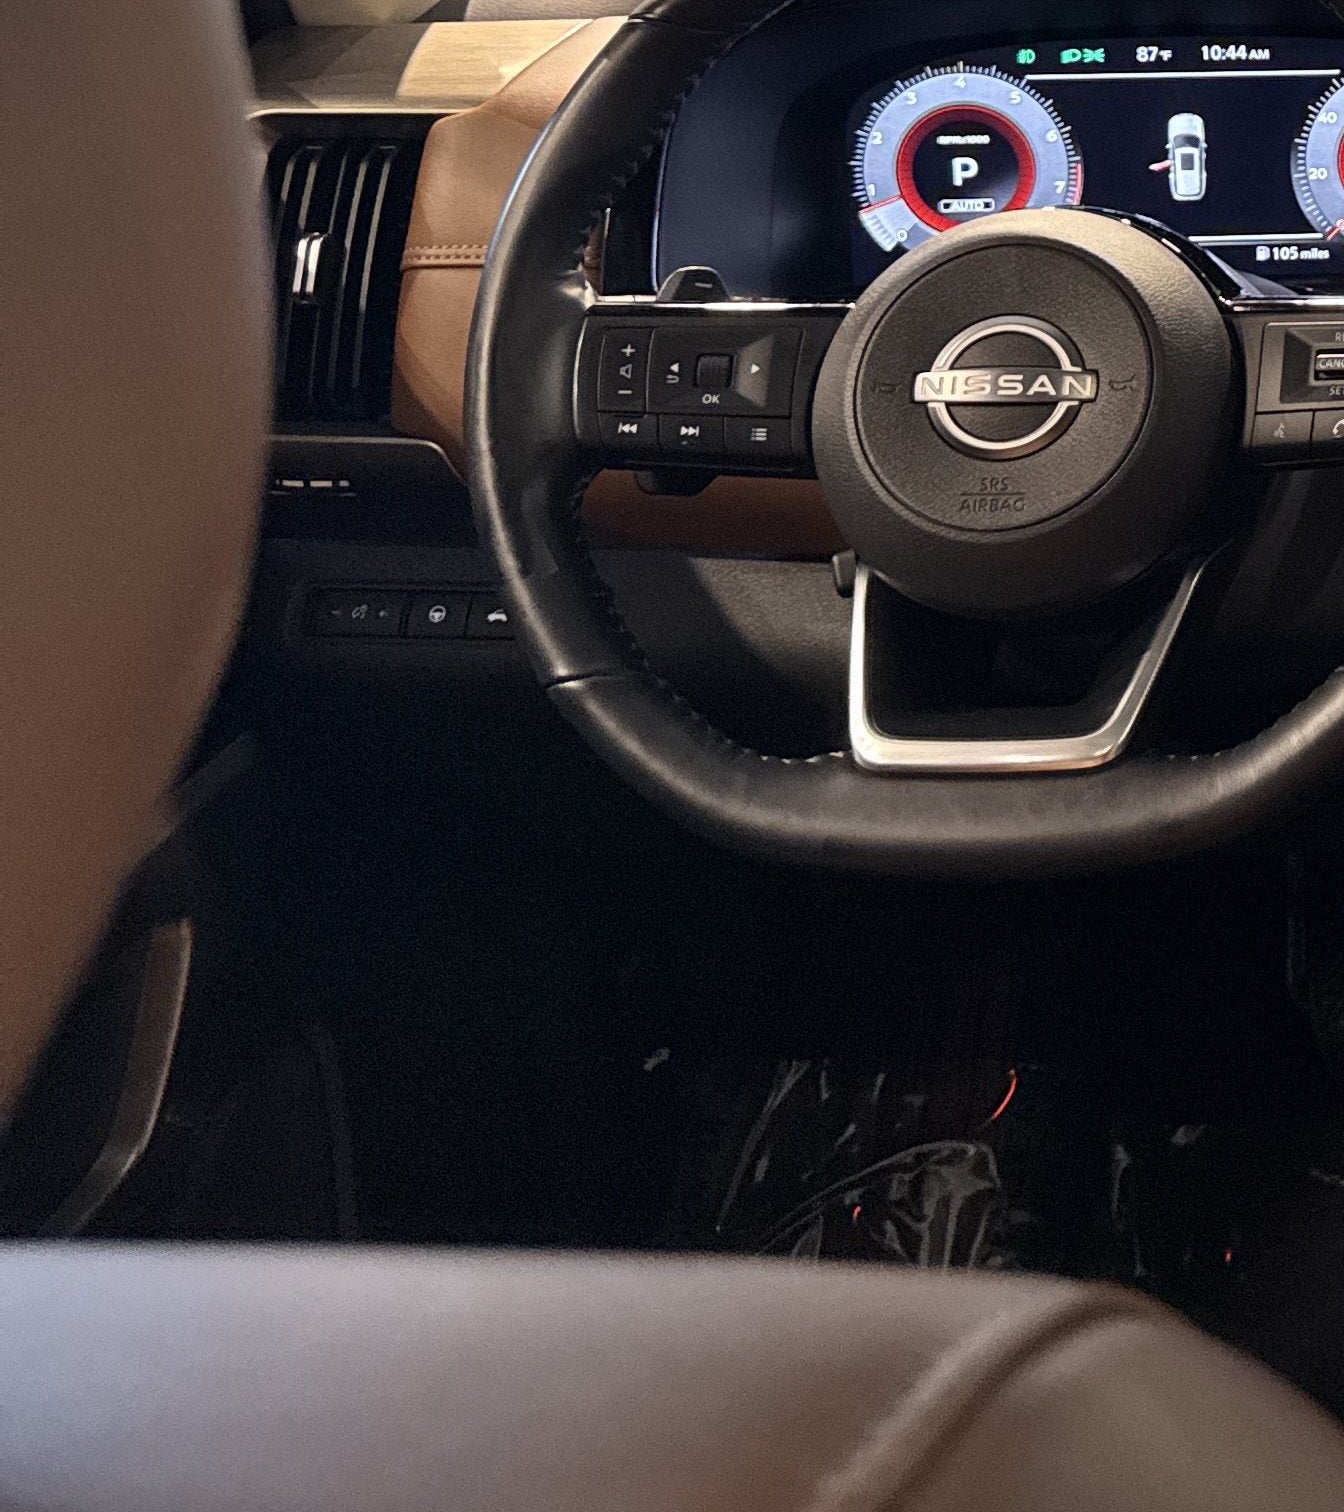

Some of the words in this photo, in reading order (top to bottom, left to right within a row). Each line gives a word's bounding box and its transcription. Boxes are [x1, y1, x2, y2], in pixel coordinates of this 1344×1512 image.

[954, 76, 966, 88] 4
[906, 91, 917, 105] 3
[1010, 90, 1021, 104] 5
[1318, 112, 1338, 124] 40
[872, 131, 883, 145] 2
[1046, 130, 1058, 143] 6
[951, 156, 979, 187] P
[1309, 168, 1328, 179] 20
[867, 184, 876, 196] 1
[1054, 180, 1066, 194] 7
[1272, 246, 1299, 261] 105
[1300, 246, 1330, 261] miles
[920, 374, 1092, 396] NISSAN
[702, 393, 720, 404] OK
[980, 476, 1009, 491] SRS
[959, 497, 1026, 513] AIRBAG
